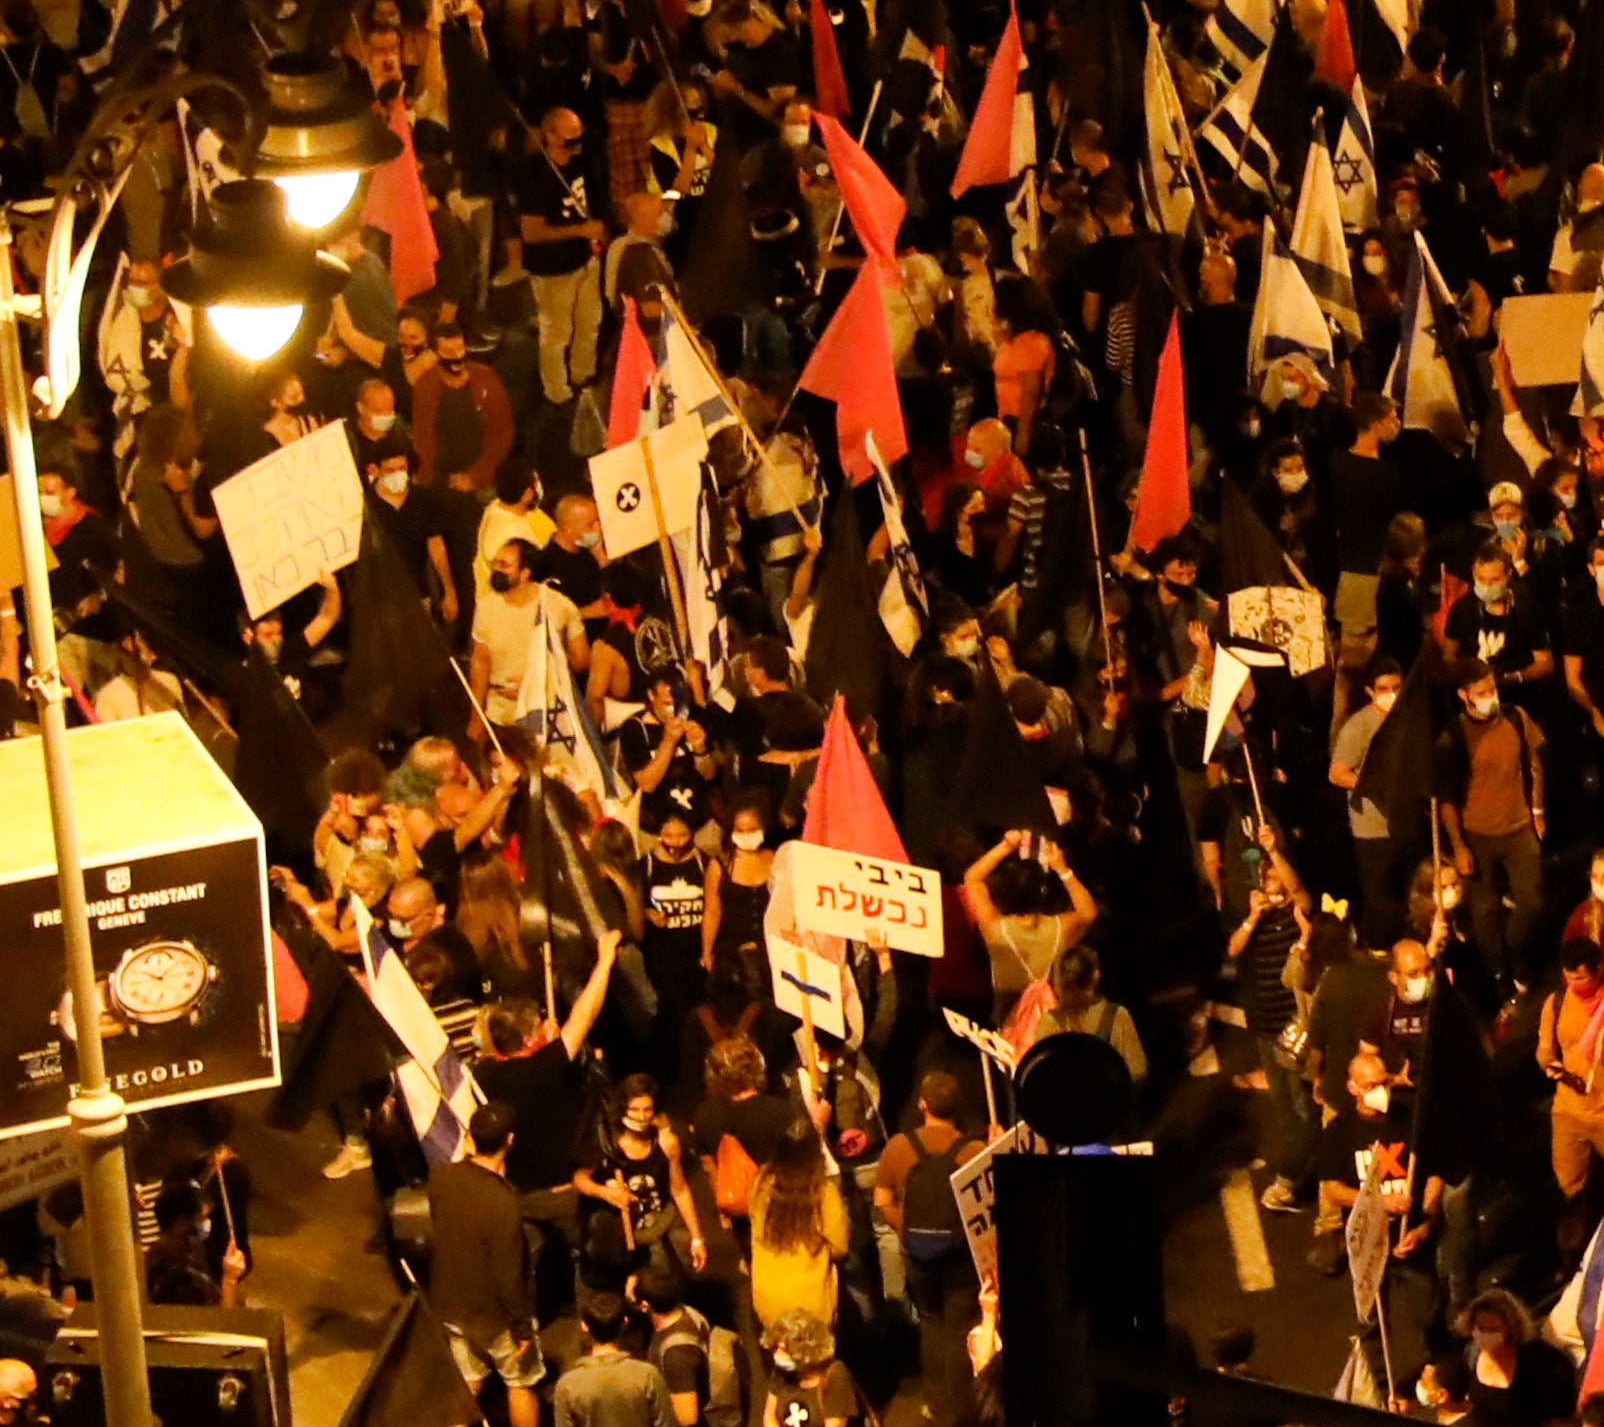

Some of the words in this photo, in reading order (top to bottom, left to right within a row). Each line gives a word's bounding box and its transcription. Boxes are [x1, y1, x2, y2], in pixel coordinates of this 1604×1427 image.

[855, 858, 927, 894] ביבי
[33, 896, 126, 930] FRERIQUE
[127, 884, 207, 917] CONSTANT
[816, 880, 929, 932] נכשלת
[68, 1058, 205, 1099] FEGOLD
